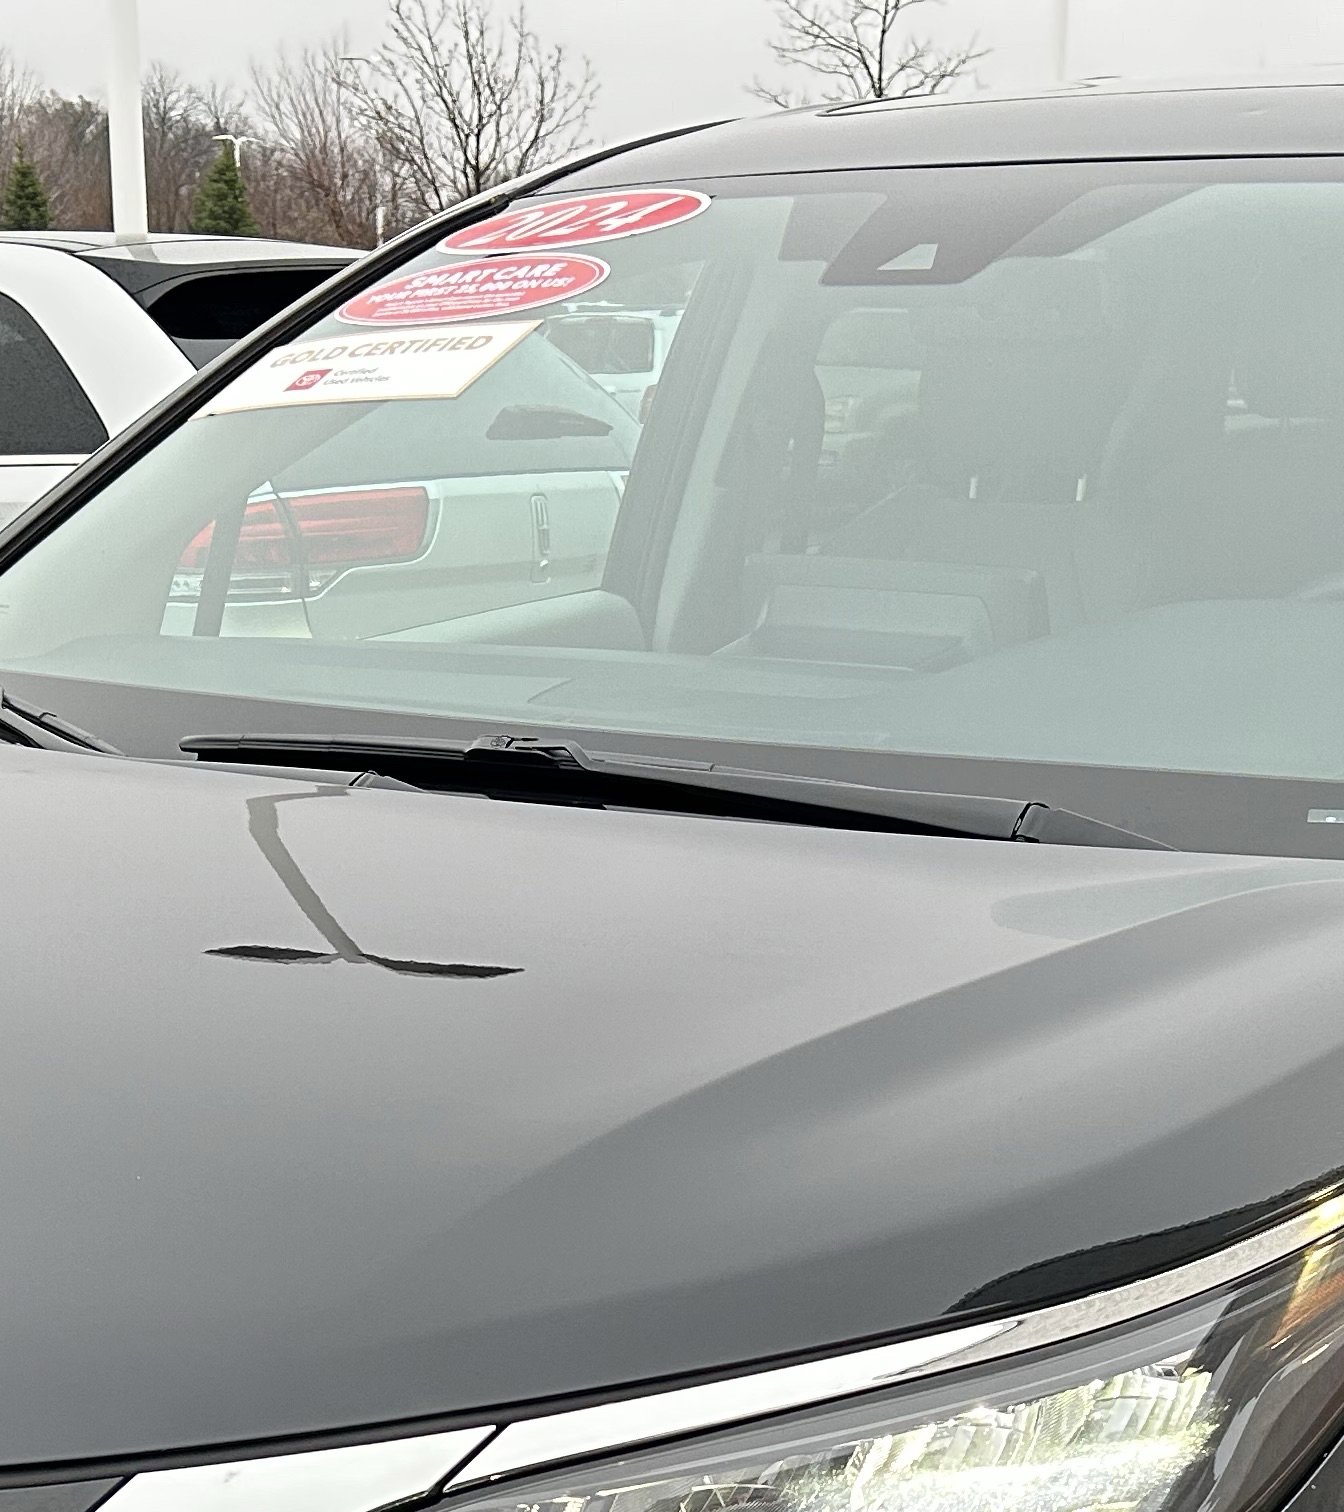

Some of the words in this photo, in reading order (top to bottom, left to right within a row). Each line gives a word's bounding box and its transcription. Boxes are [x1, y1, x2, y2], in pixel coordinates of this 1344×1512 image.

[459, 196, 686, 248] 2024
[406, 268, 496, 290] SMART
[493, 262, 568, 281] CARE
[270, 346, 347, 368] GOLD
[348, 335, 494, 359] CERTIFIED
